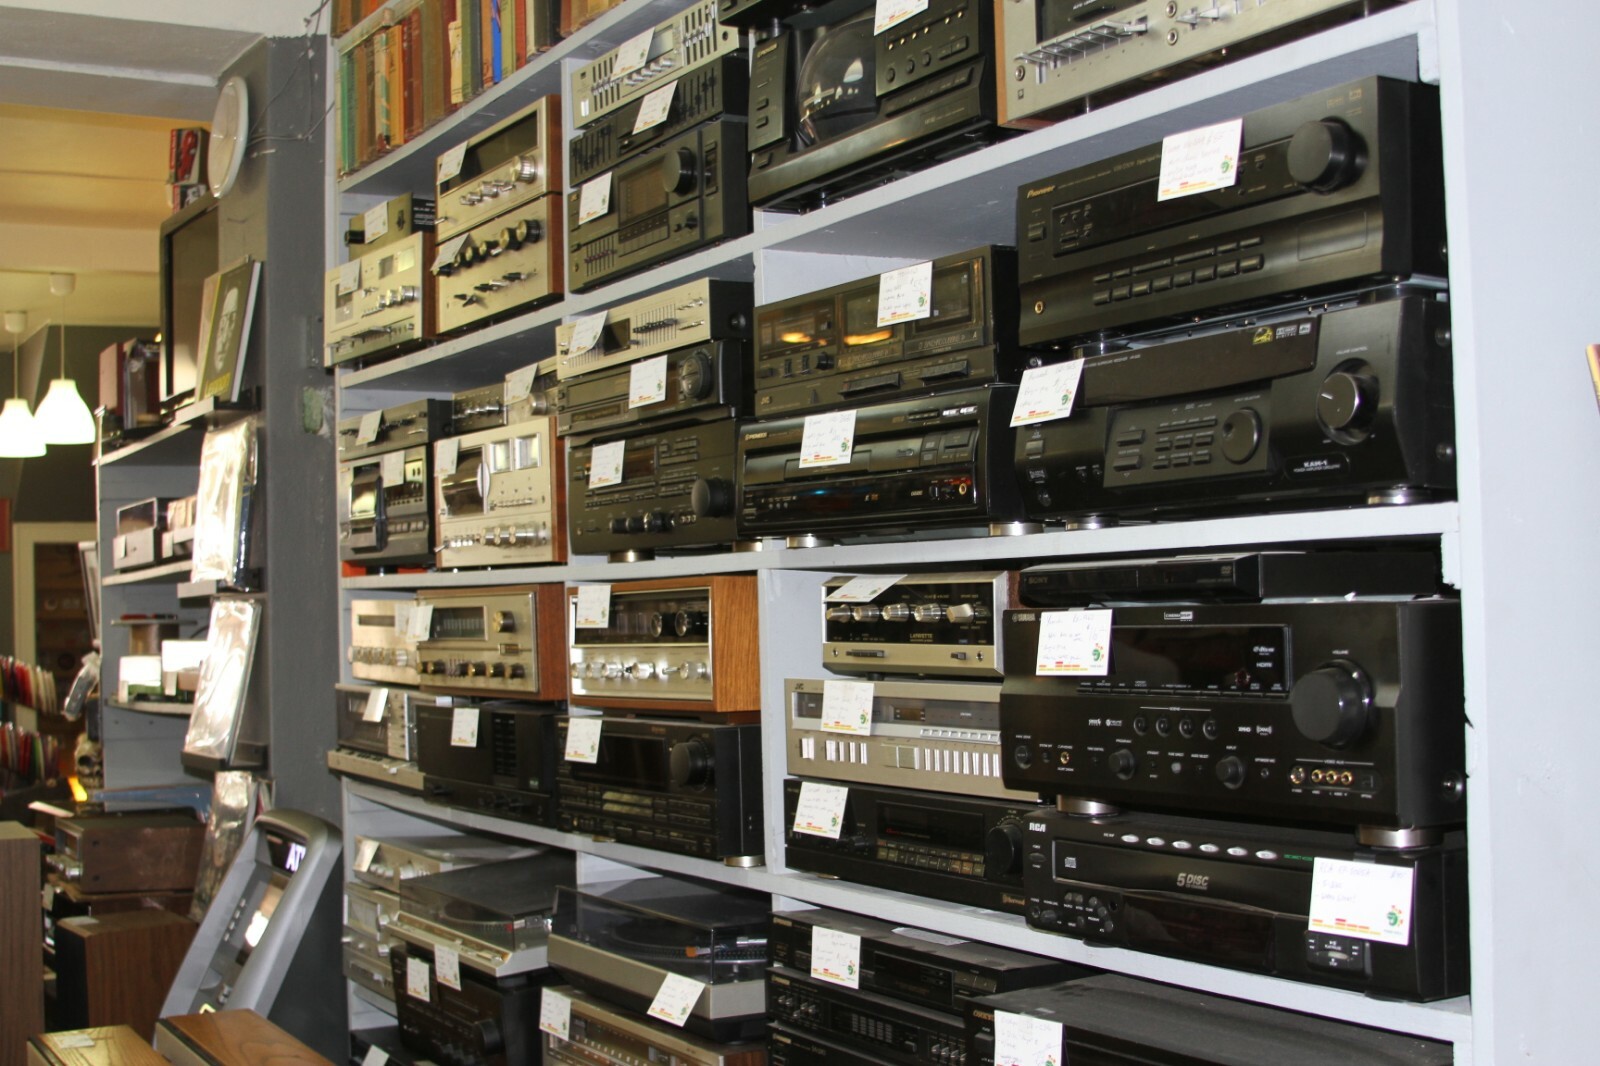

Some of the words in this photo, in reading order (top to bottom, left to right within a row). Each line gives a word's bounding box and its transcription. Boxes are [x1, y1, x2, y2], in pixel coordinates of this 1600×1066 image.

[1029, 822, 1047, 833] RCA
[1176, 872, 1187, 887] 5
[1186, 873, 1209, 886] DISC
